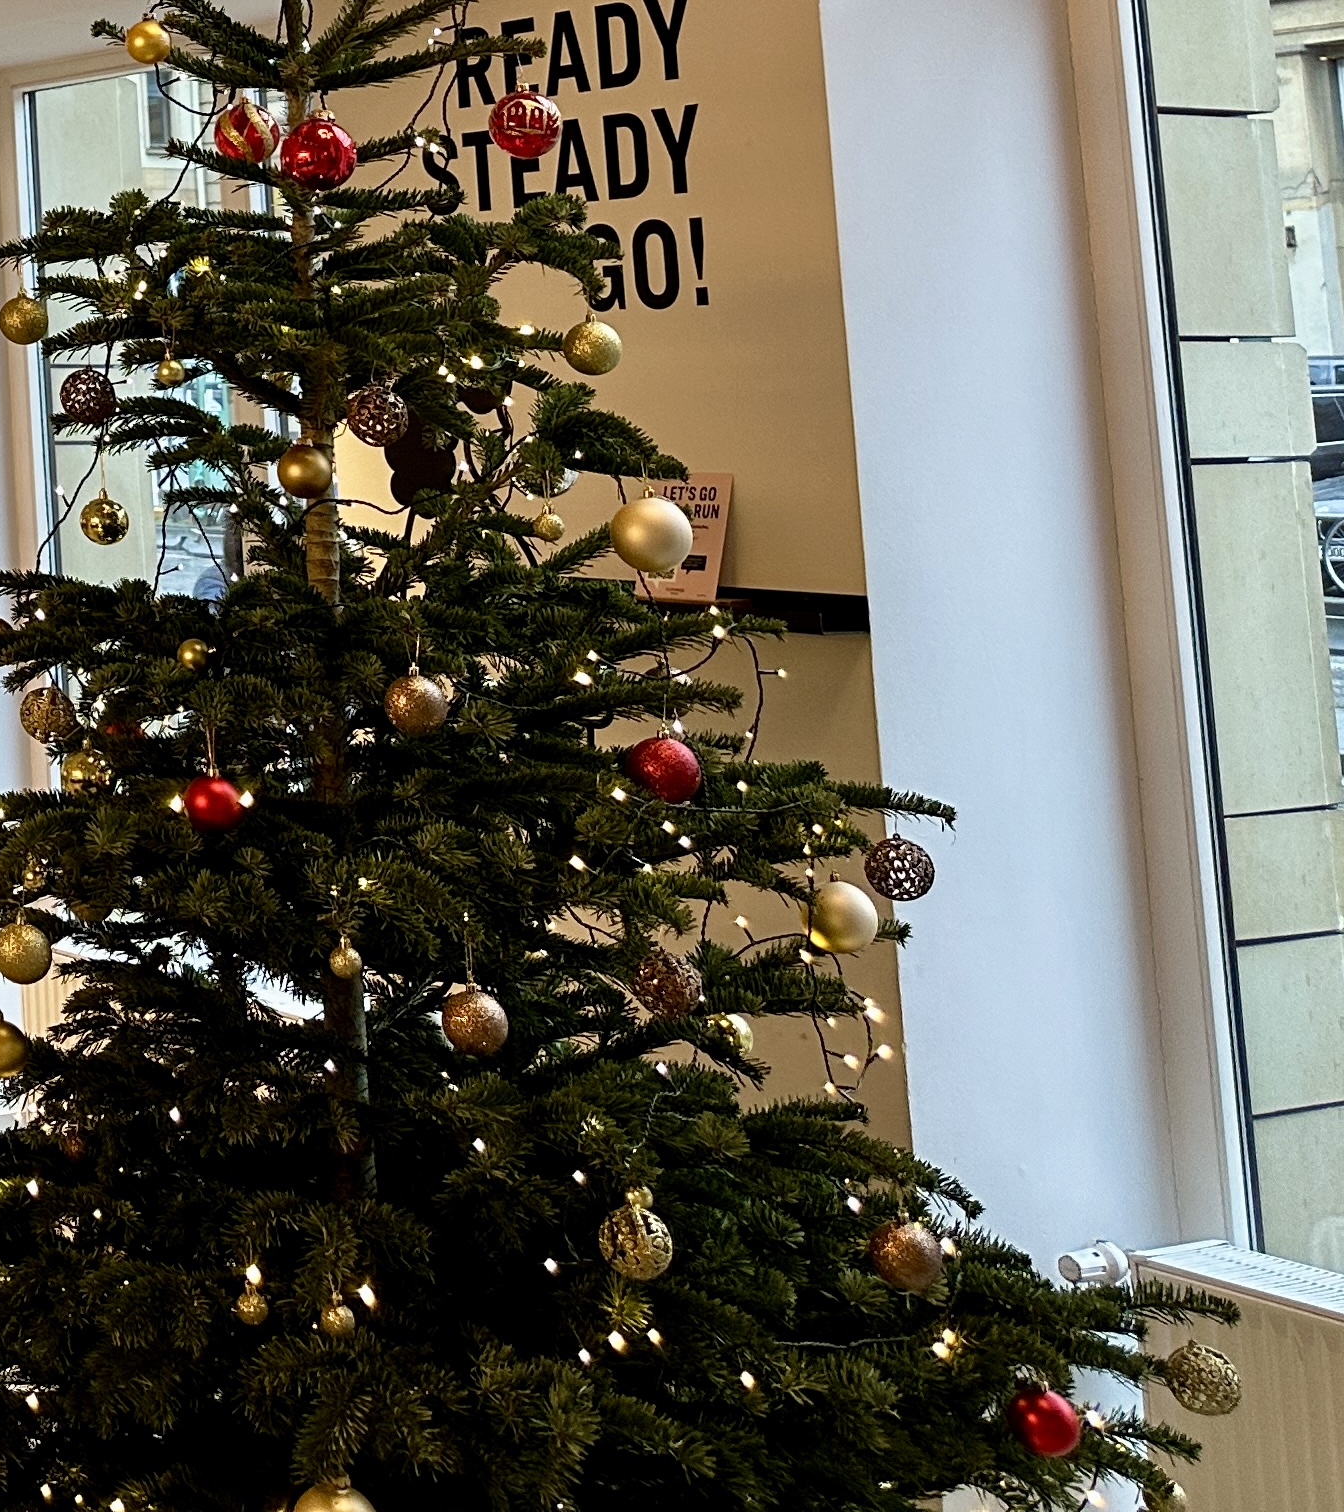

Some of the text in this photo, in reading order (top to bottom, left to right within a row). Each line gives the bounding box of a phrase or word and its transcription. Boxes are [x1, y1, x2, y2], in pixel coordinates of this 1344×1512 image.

[422, 103, 699, 216] STEADY
[663, 486, 717, 501] LET'S GO
[694, 504, 720, 519] RUN
